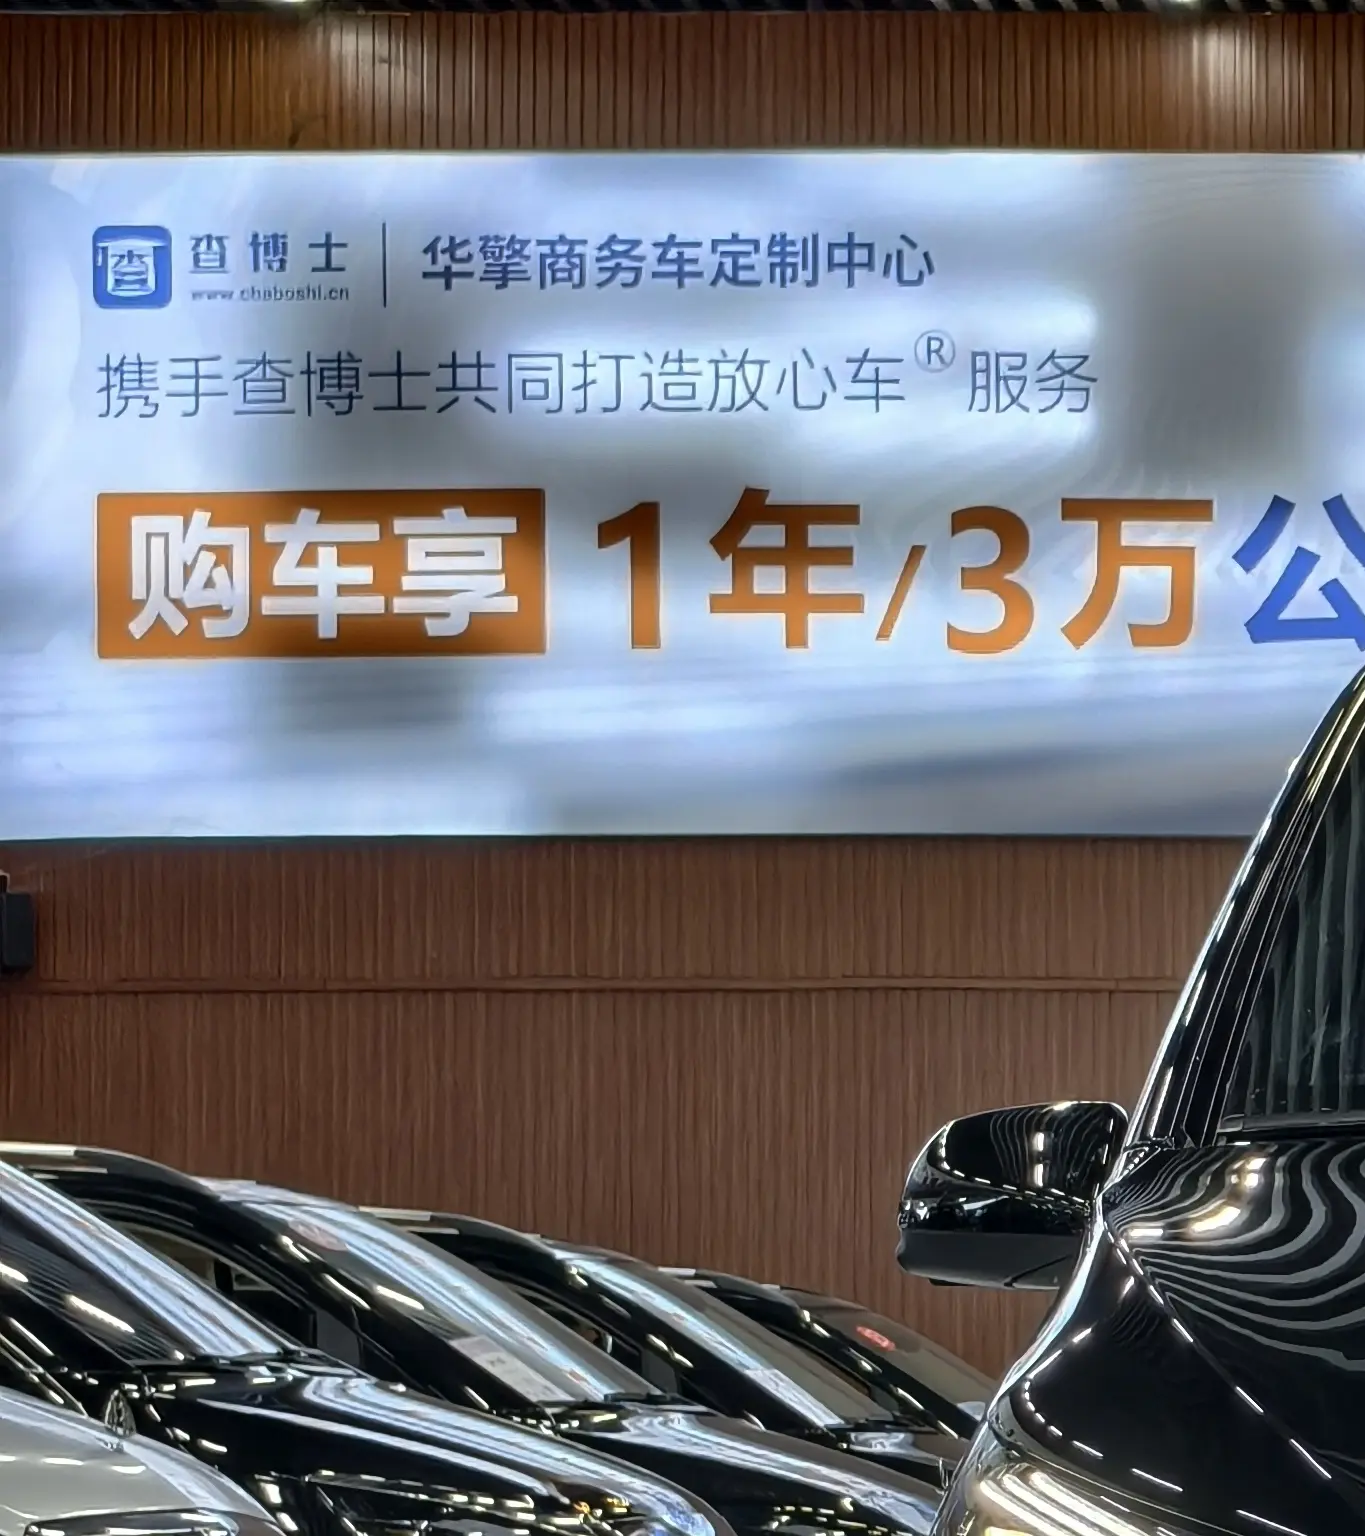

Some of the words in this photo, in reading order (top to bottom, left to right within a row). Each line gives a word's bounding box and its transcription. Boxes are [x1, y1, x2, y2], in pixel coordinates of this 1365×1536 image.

[188, 230, 349, 274] 查博士
[420, 231, 936, 292] 华擎商务车定制中心
[128, 507, 521, 641] 购车享
